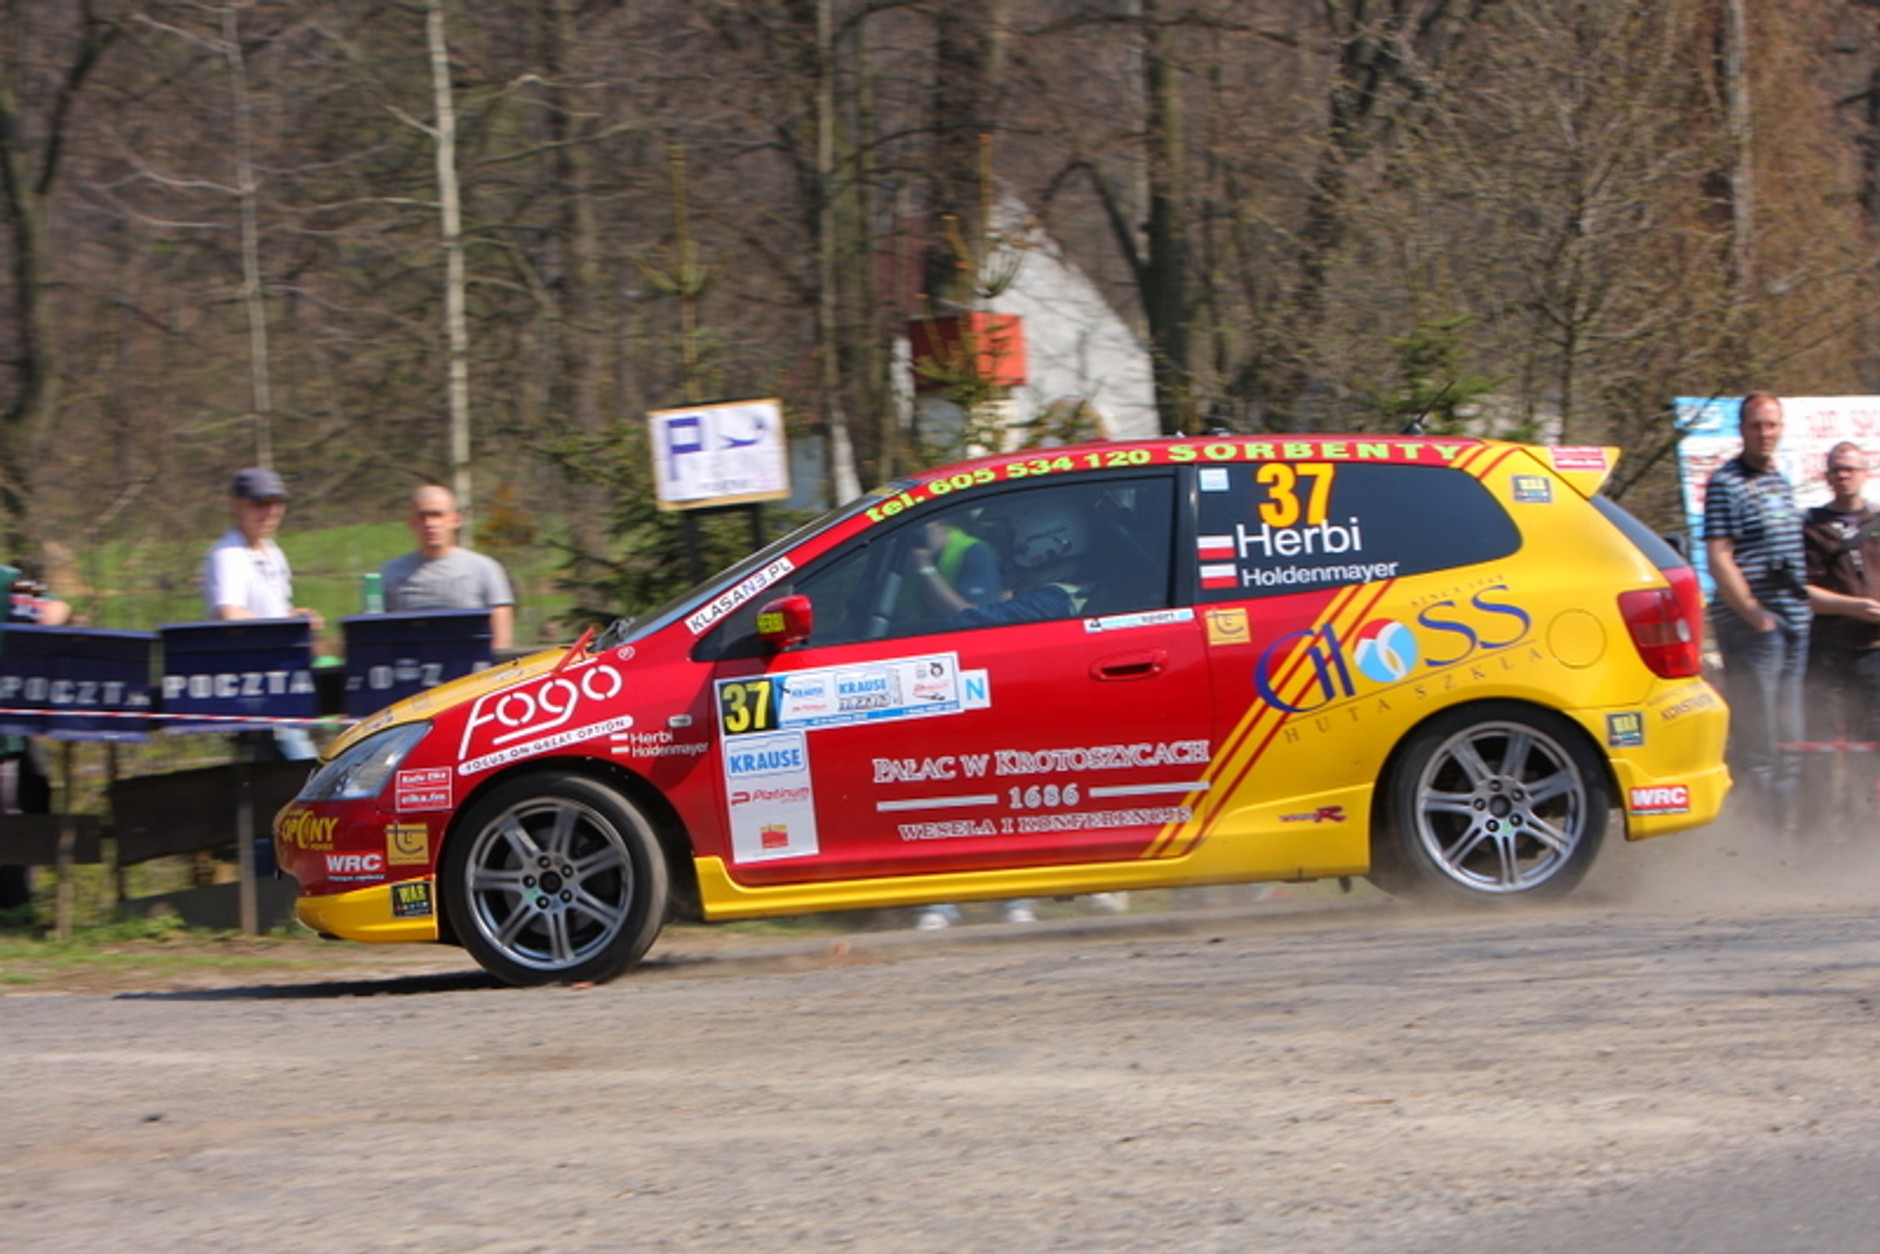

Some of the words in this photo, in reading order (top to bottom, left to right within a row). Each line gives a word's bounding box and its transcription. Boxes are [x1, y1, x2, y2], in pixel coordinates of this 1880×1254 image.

[865, 494, 925, 522] tel.
[928, 468, 996, 495] 605
[1007, 456, 1073, 478] 534
[1084, 450, 1150, 468] 120
[1168, 443, 1462, 461] SORBENTY
[1256, 463, 1336, 526] 37
[1236, 517, 1362, 558] Herbi
[1242, 561, 1399, 587] Holdenmayer
[162, 671, 315, 699] POCZTA
[838, 679, 887, 694] KRAUSE
[965, 678, 986, 701] N
[722, 681, 771, 732] 37
[1284, 699, 1392, 744] HUTA
[510, 746, 530, 758] ON
[536, 733, 573, 751] GREAT
[630, 732, 673, 744] Herbi
[632, 742, 709, 757] Holdenmayer
[730, 749, 801, 773] KRAUSE
[959, 754, 990, 778] W
[1009, 783, 1080, 809] 1686
[1632, 787, 1687, 807] WRC
[1001, 818, 1014, 833] I
[325, 854, 382, 872] WRC
